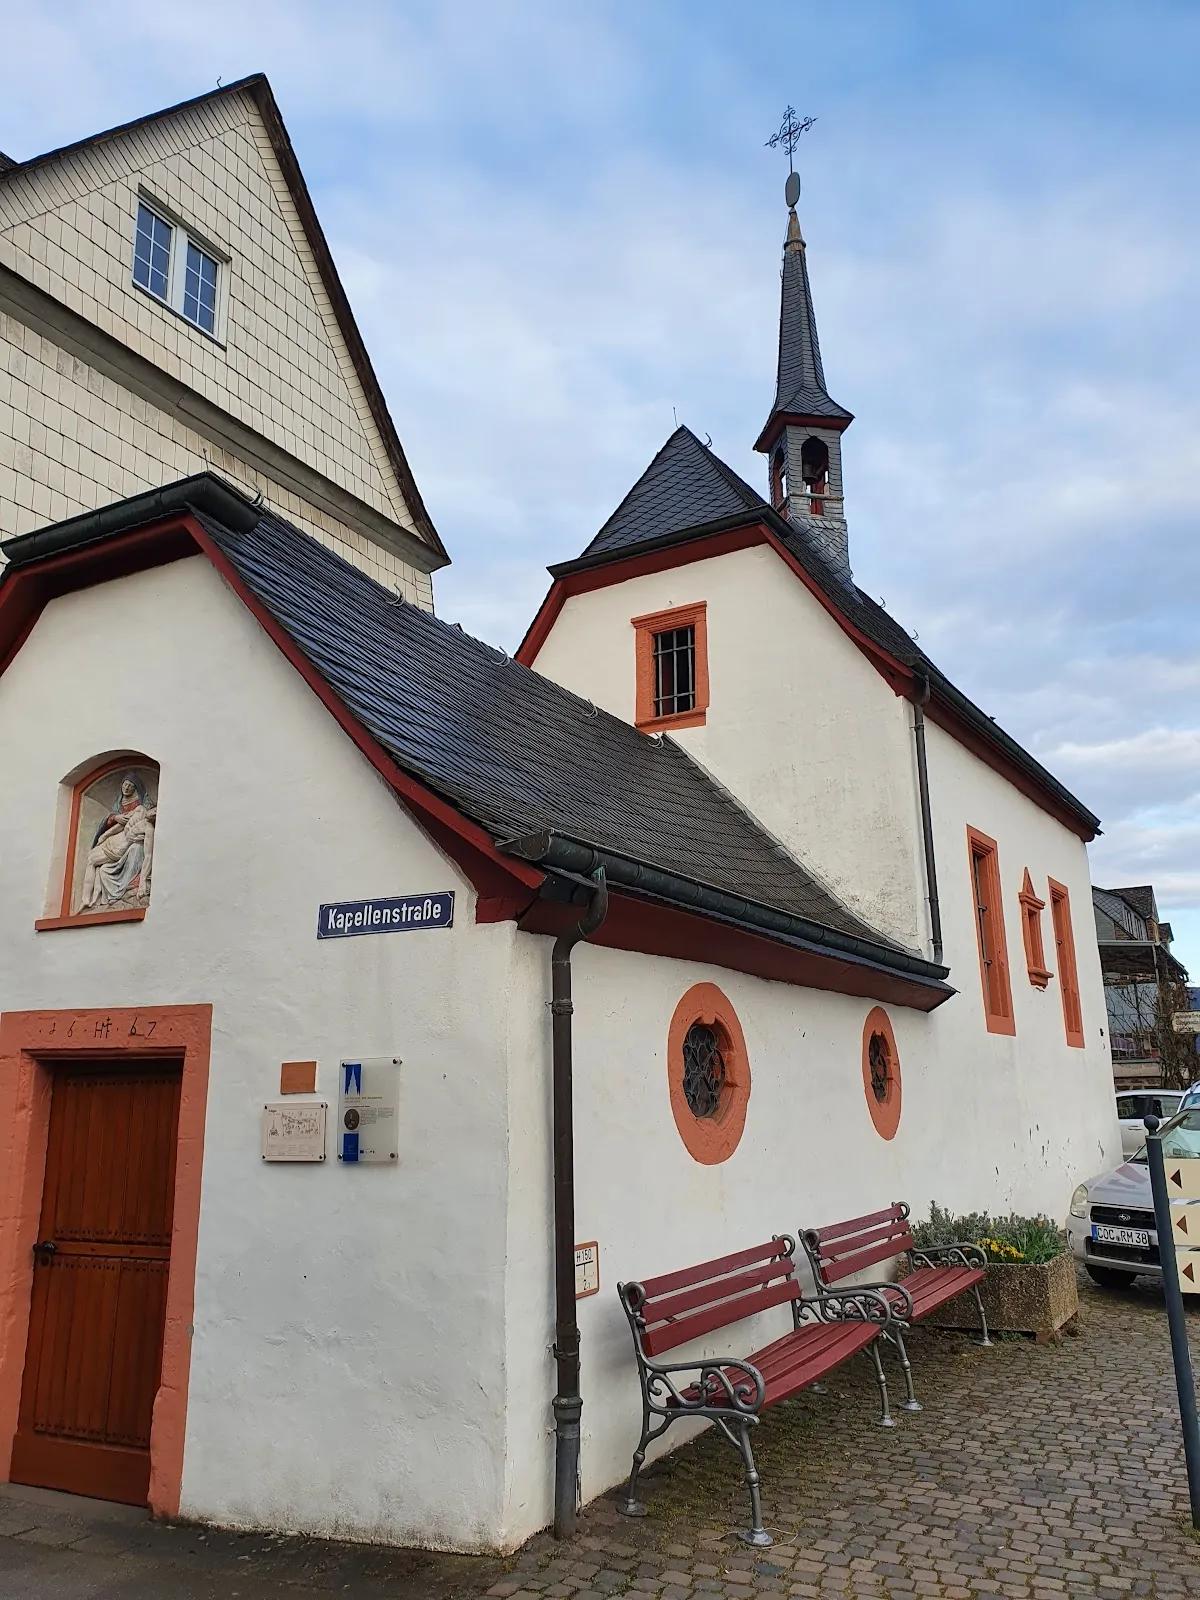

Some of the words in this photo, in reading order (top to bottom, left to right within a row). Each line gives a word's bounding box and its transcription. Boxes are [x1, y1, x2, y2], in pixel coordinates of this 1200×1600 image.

[327, 899, 442, 933] Kapellenstraße
[1097, 1227, 1115, 1240] COC
[1120, 1230, 1133, 1243] RM
[1135, 1232, 1148, 1245] 38
[576, 1251, 581, 1263] H
[581, 1248, 592, 1261] 150
